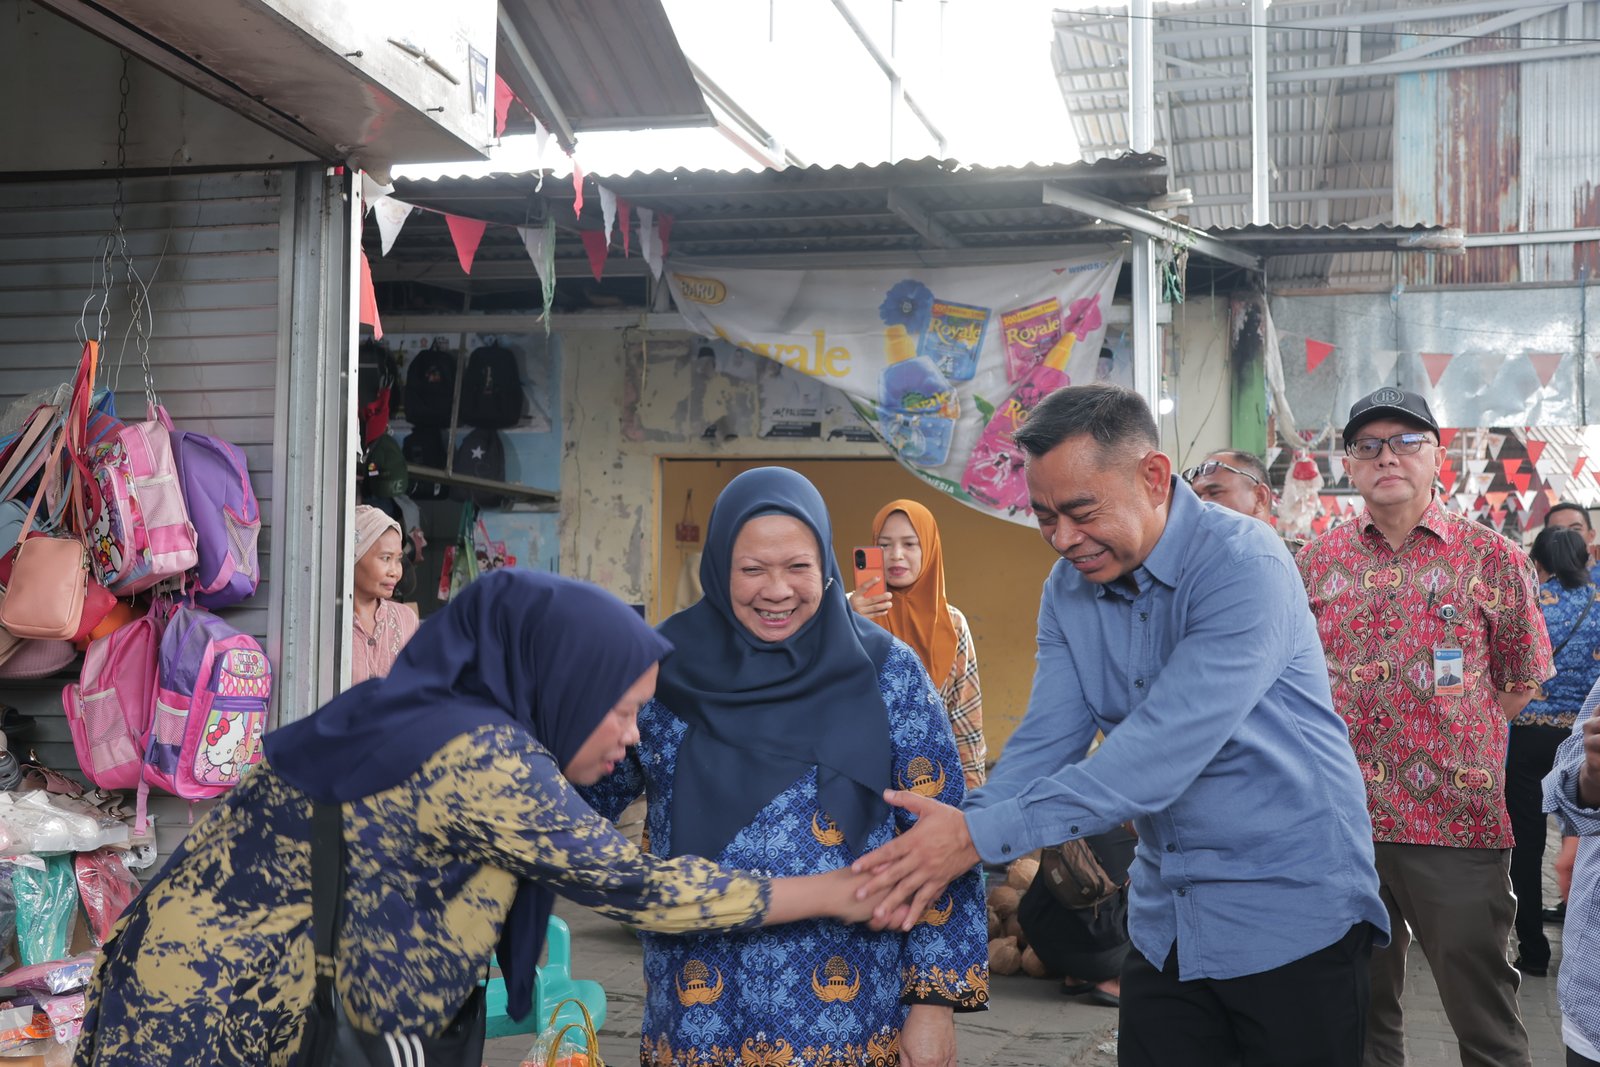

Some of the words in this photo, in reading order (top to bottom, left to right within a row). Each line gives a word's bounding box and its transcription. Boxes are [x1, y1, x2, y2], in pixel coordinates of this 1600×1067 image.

[928, 317, 982, 345] Royale
[1006, 317, 1061, 348] Royale
[237, 653, 259, 664] HELLO
